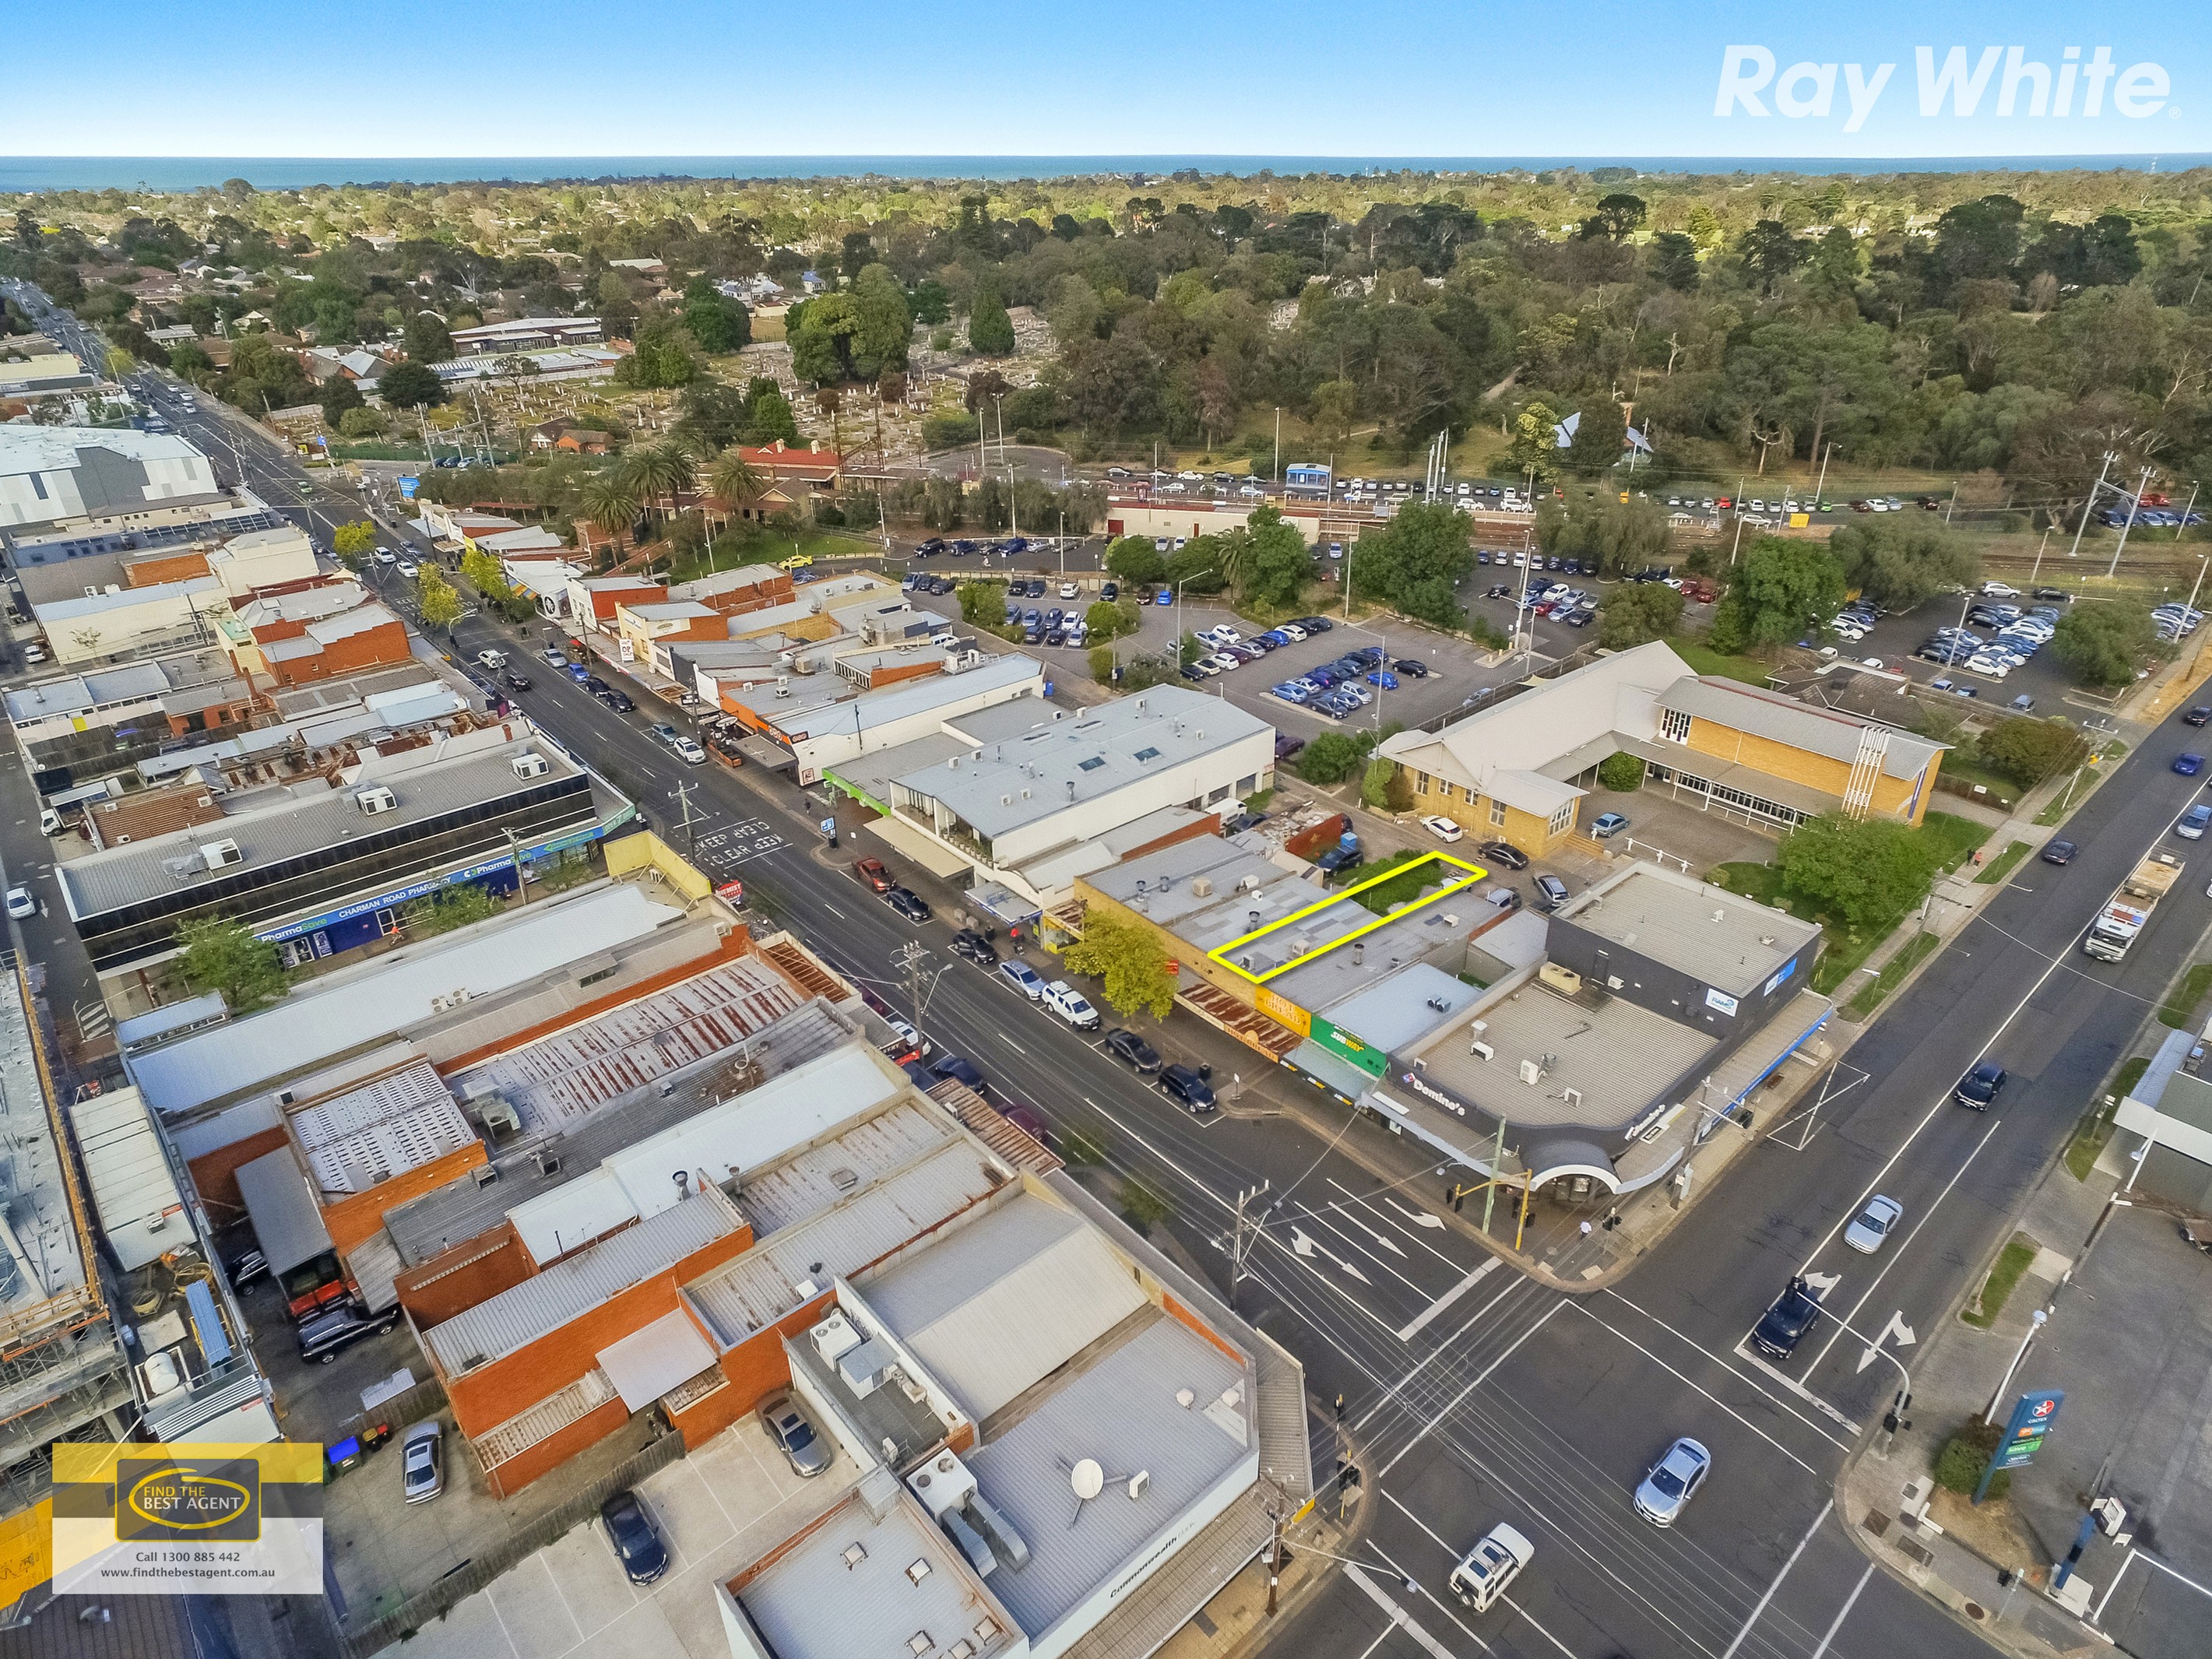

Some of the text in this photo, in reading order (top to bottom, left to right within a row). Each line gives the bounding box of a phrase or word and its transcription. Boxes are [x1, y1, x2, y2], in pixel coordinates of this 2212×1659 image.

[733, 821, 770, 838] CLEAR
[698, 834, 728, 851] KEEP
[754, 834, 784, 850] KEEP
[712, 845, 752, 865] CLEAR
[339, 900, 380, 918] CHARMAN
[383, 891, 406, 905] ROAD
[261, 919, 327, 944] PharmaSave
[1264, 997, 1301, 1025] BREAD
[1271, 993, 1294, 1012] HOT
[1330, 1031, 1365, 1052] SUBWAY
[1414, 1079, 1465, 1116] Domino's
[1110, 1536, 1177, 1599] Commonwealth
